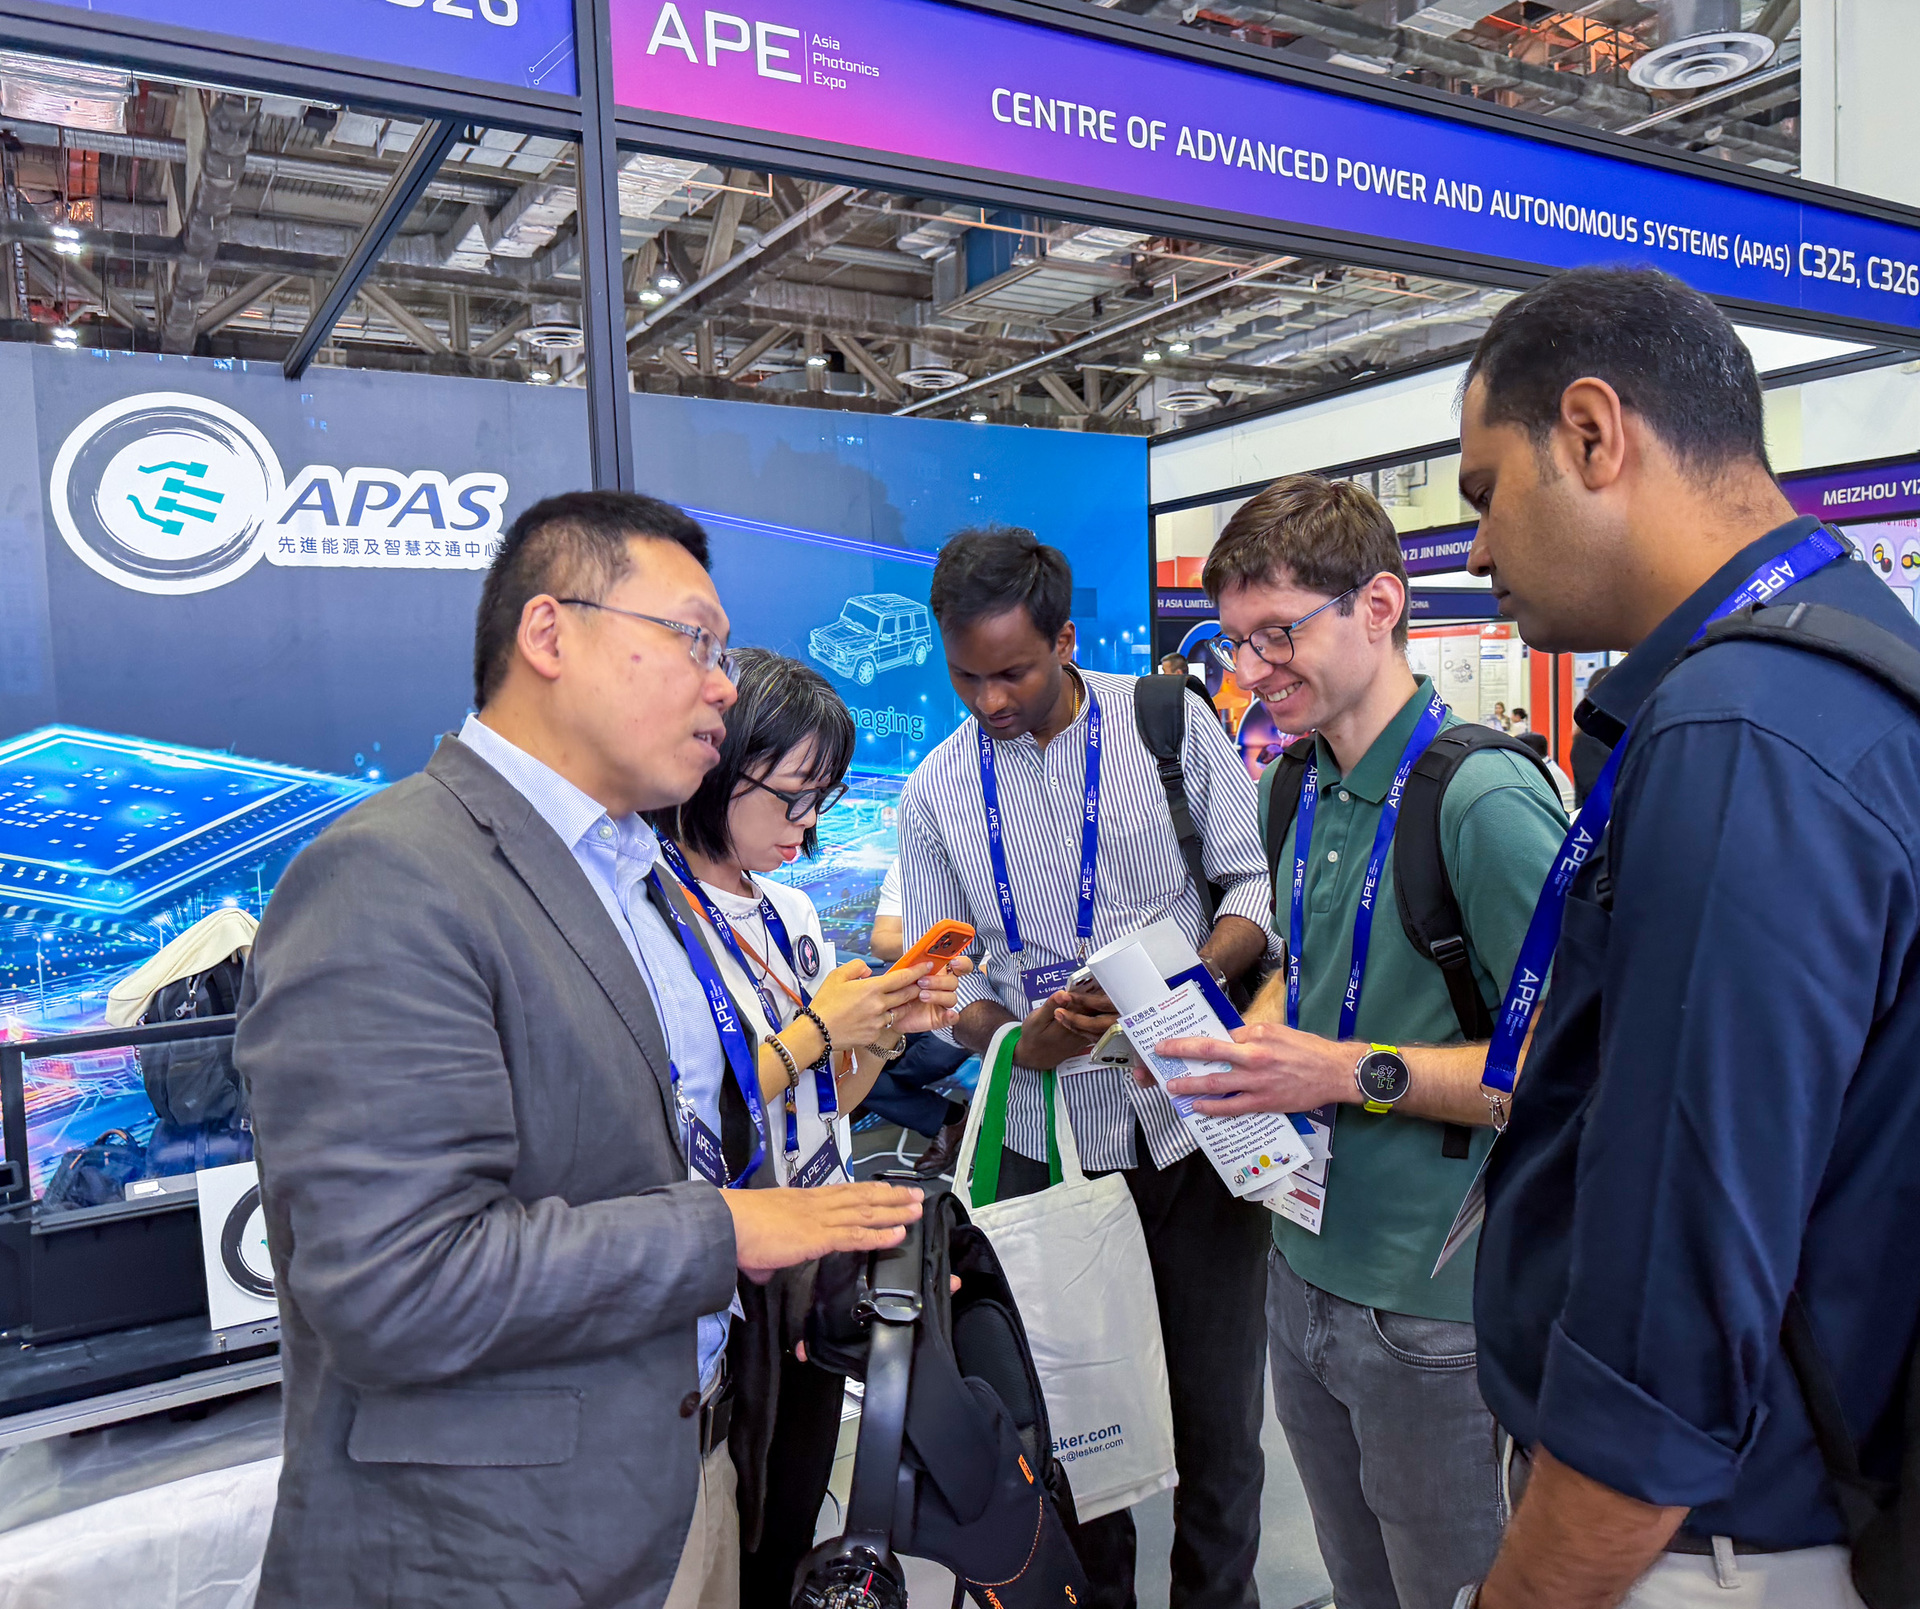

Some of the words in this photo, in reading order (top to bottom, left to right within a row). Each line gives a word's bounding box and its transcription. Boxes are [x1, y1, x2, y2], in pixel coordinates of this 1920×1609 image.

[646, 1, 802, 84] APE
[812, 33, 840, 51] Asia
[812, 53, 880, 77] Photonics
[813, 71, 847, 90] Expo
[991, 87, 1118, 144] CENTRE
[1126, 115, 1167, 152] OF
[1176, 126, 1329, 184] ADVANCED
[1337, 157, 1427, 203] POWER
[1433, 178, 1483, 213] AND
[1490, 189, 1638, 243] AUTONOMOUS
[1643, 219, 1729, 261] SYSTEMS
[1734, 233, 1791, 278] (APAS)
[1799, 242, 1861, 288] C325,
[1867, 255, 1920, 296] C326
[276, 477, 497, 532] APAS
[1823, 481, 1897, 506] MEIZHOU
[1747, 560, 1795, 601] APE
[1165, 599, 1184, 608] ASIA
[981, 733, 992, 758] APE
[1089, 723, 1099, 749] APE
[1307, 764, 1318, 795] APE
[1388, 775, 1407, 809] APE
[988, 806, 1000, 831] APE
[1086, 796, 1096, 823] APE
[1560, 826, 1594, 873] APE
[1294, 857, 1305, 888] APE
[998, 881, 1011, 907] APE
[1081, 874, 1093, 900] APE
[1361, 875, 1376, 910] APE
[707, 905, 728, 932] APE
[1036, 970, 1062, 986] APE
[1289, 955, 1299, 986] APE
[1345, 977, 1359, 1011] APE
[1510, 968, 1540, 1017] APE
[713, 996, 737, 1033] APE
[1132, 1025, 1154, 1038] Cherry
[1199, 1122, 1215, 1134] URL:
[1249, 1117, 1279, 1134] Development
[695, 1131, 711, 1158] APE
[1264, 1136, 1277, 1146] China
[801, 1162, 822, 1188] APE
